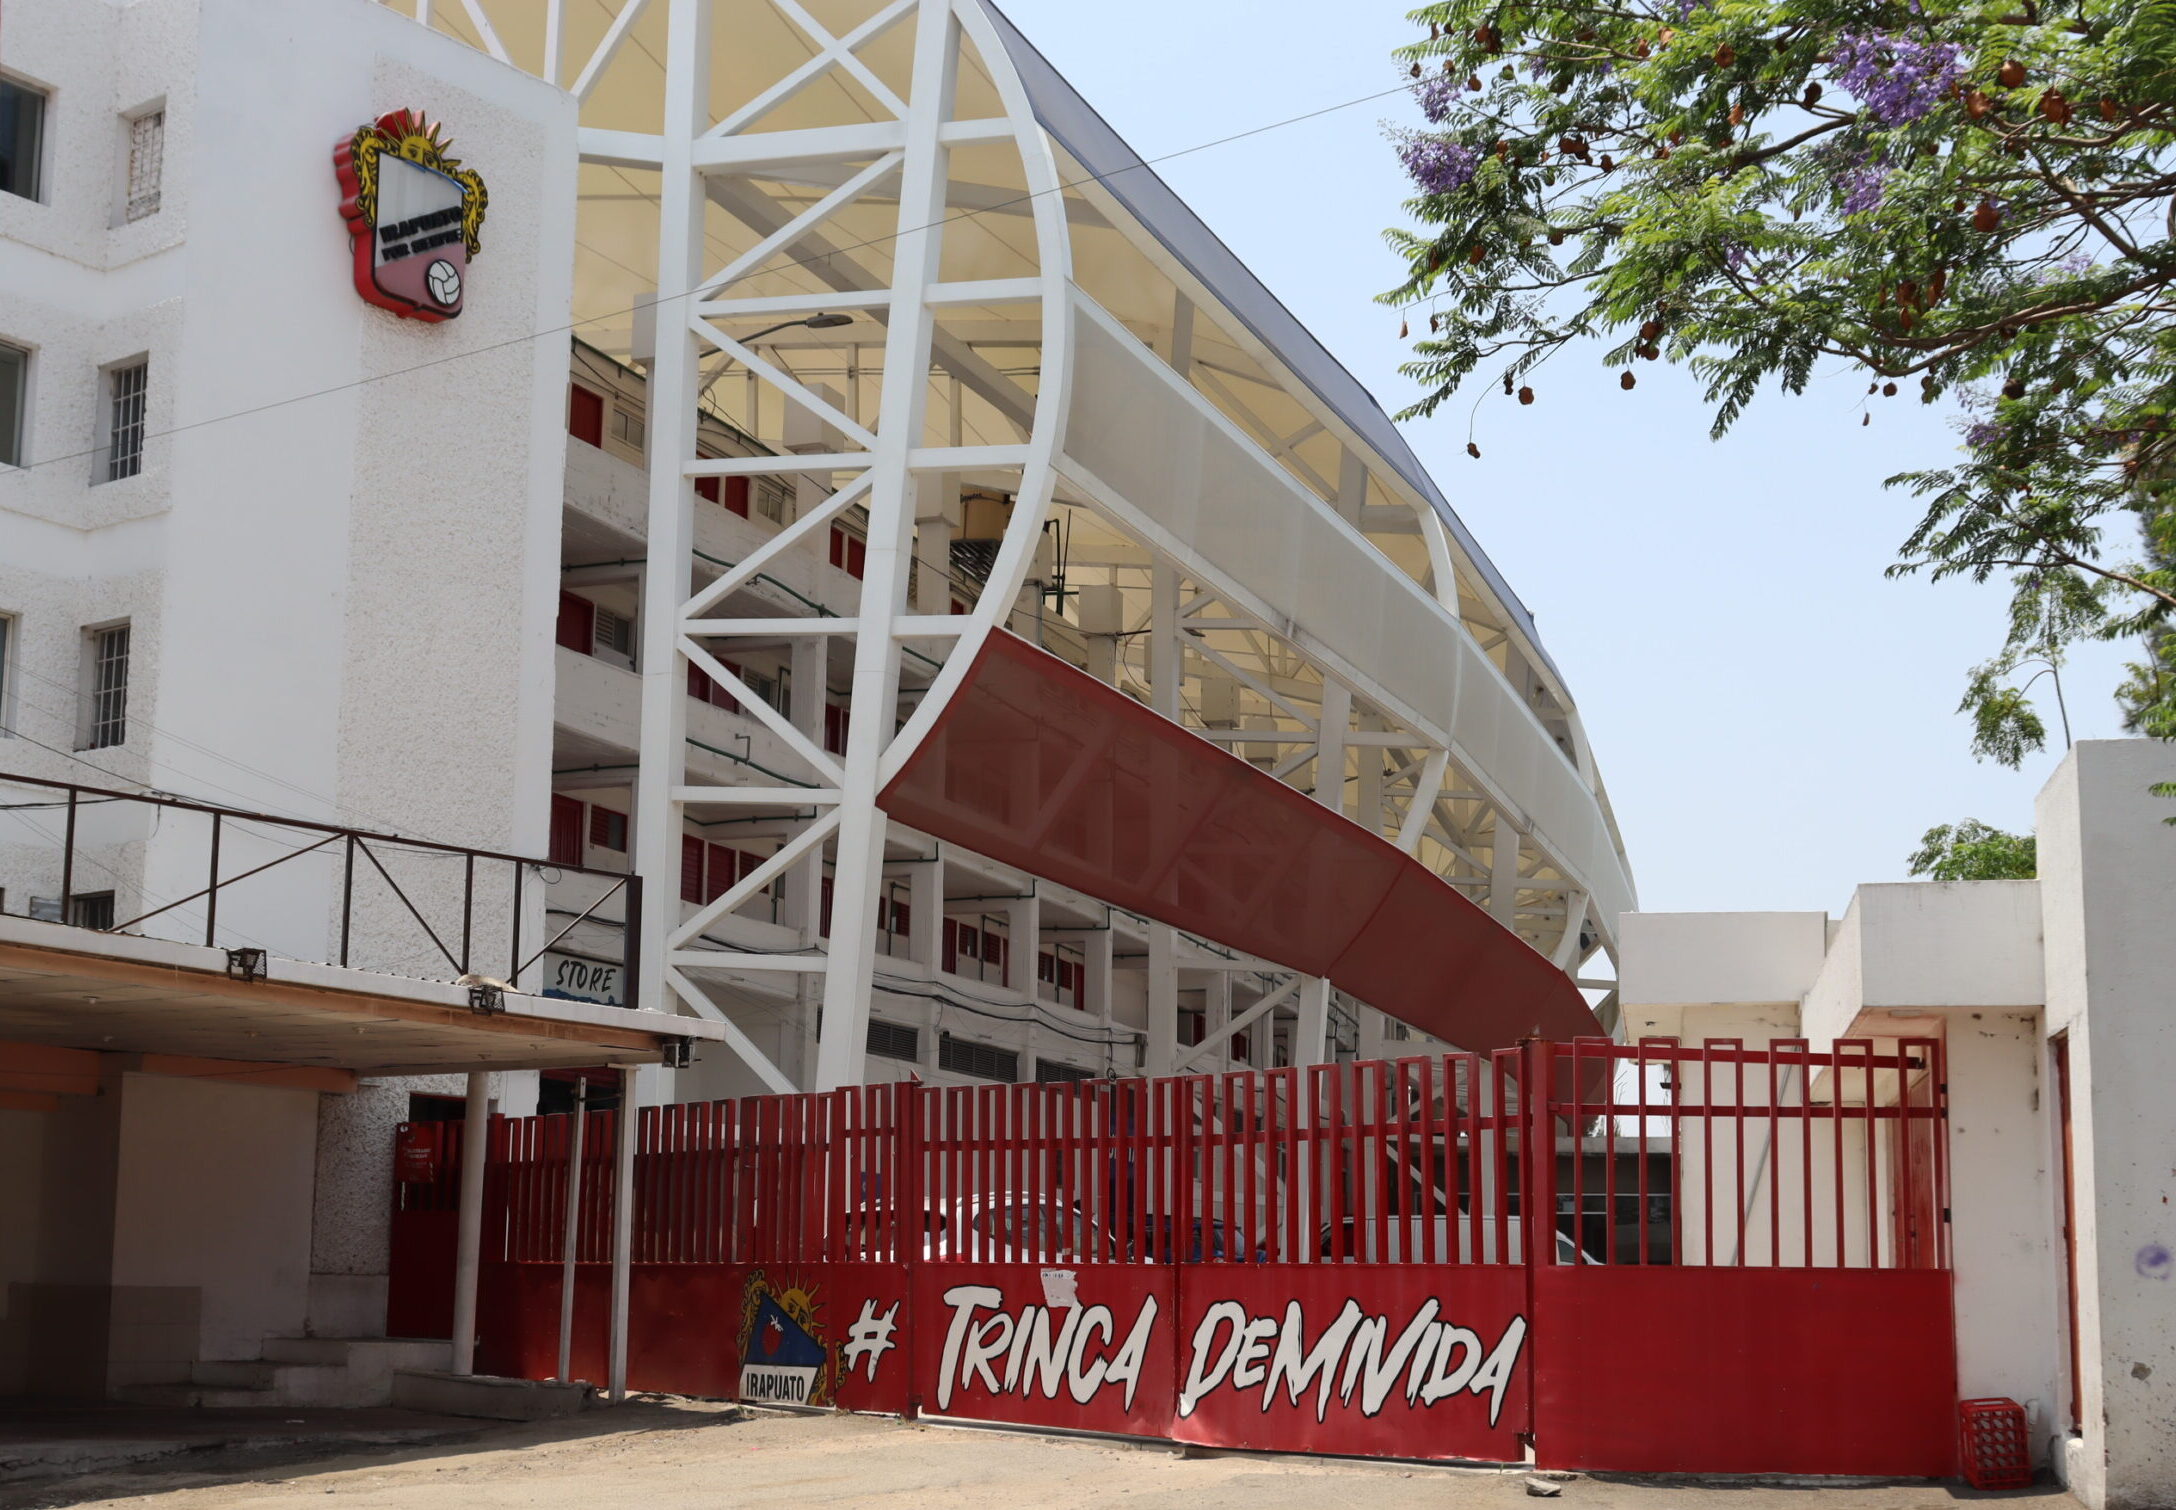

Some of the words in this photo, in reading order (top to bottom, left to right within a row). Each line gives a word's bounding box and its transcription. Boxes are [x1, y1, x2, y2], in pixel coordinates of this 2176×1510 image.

[556, 960, 617, 992] STORE
[937, 1284, 1159, 1414] TRINCA
[746, 1373, 805, 1402] IRAPUATO
